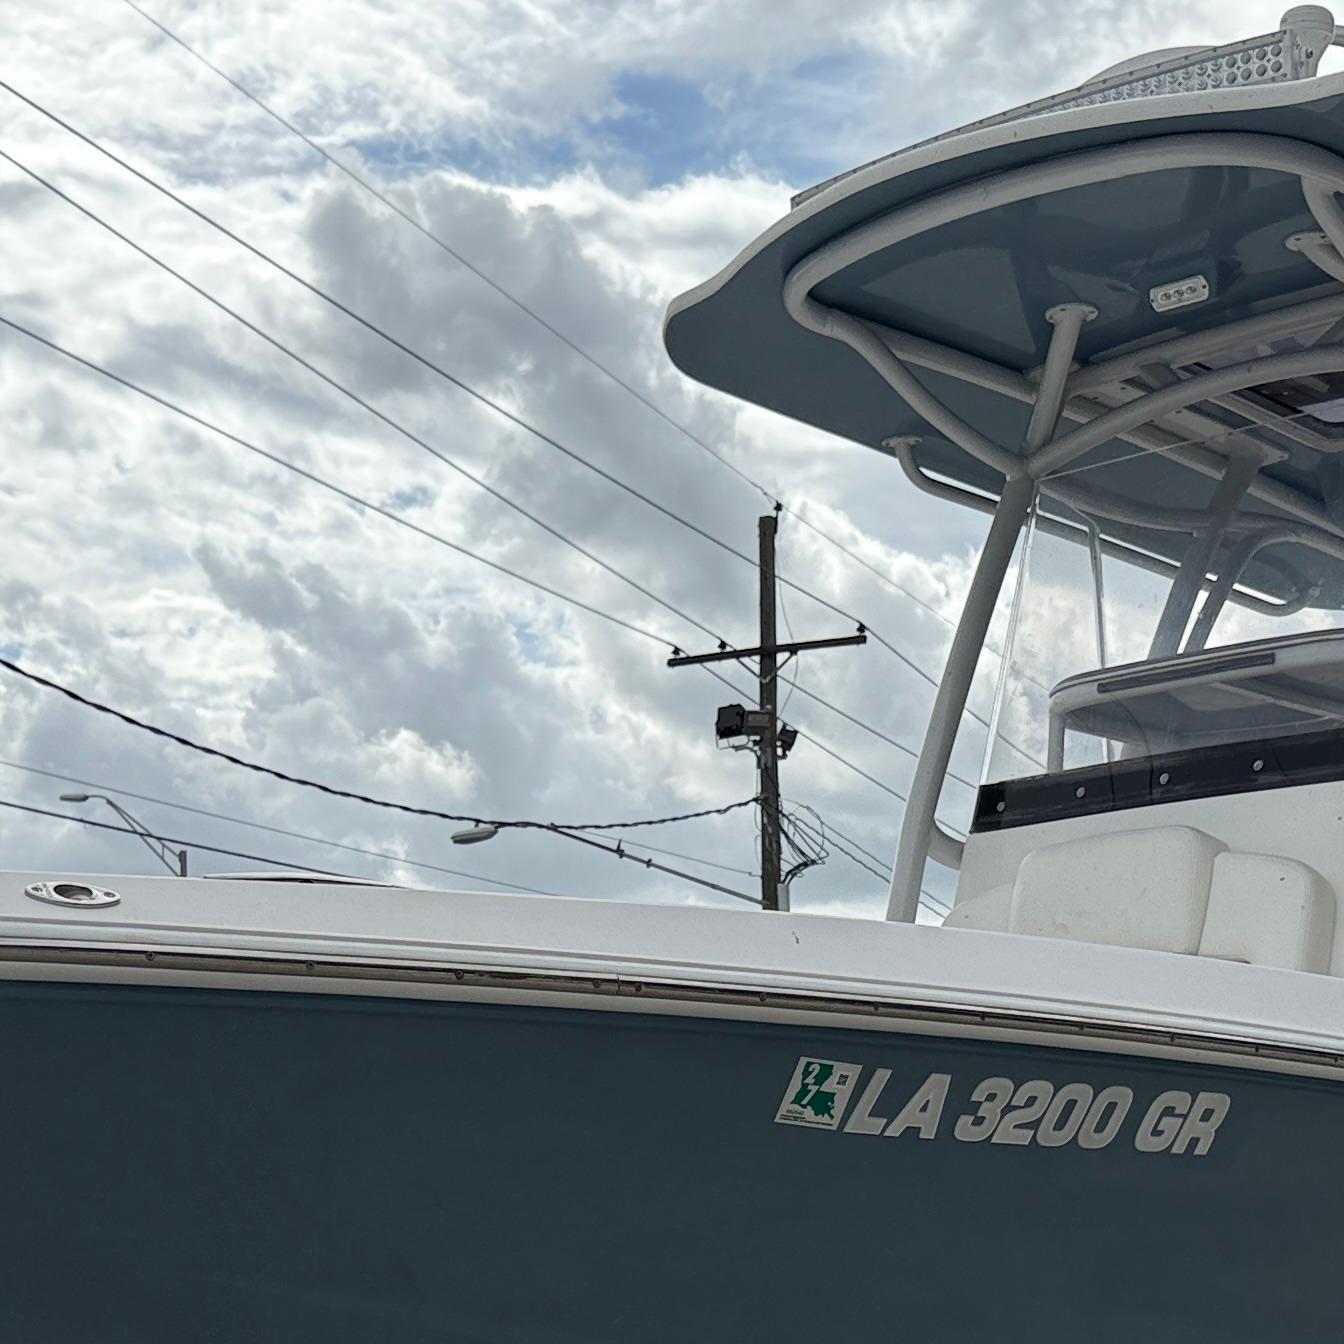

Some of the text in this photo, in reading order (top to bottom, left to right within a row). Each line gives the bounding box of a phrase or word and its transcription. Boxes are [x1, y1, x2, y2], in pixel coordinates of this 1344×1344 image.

[803, 1064, 821, 1084] 2
[800, 1085, 820, 1105] 7
[843, 1068, 1231, 1156] LA 3200 GR
